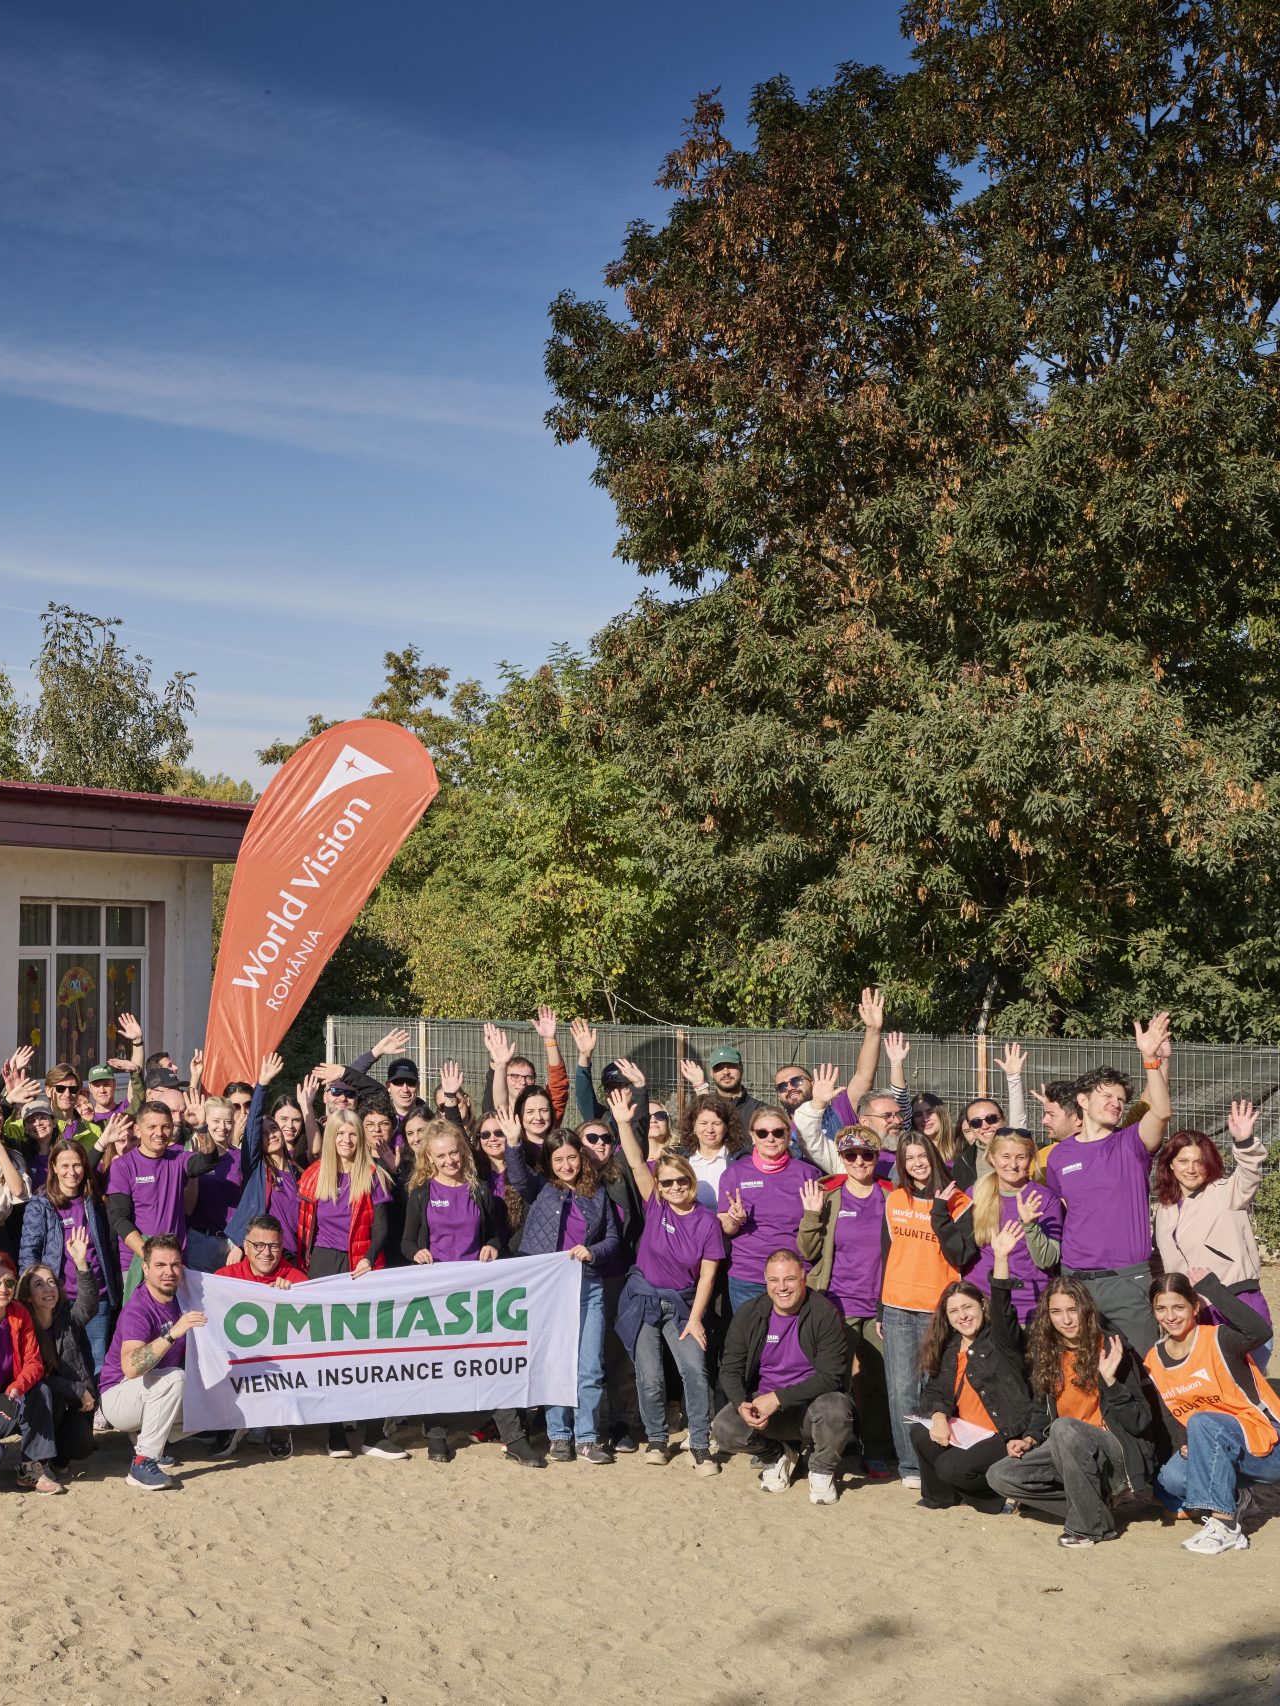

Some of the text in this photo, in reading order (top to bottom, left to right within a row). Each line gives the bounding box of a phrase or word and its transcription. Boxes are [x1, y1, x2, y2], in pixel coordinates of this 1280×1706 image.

[232, 798, 372, 989] World Vision
[266, 930, 323, 1011] ROMÂNIA
[894, 1226, 937, 1243] OLUNTEE
[223, 1286, 528, 1348] OMNIASIG
[229, 1356, 528, 1394] VIENNA INSURANCE GROUP
[1177, 1380, 1202, 1394] Vision
[1172, 1395, 1222, 1418] OLUNTEER
